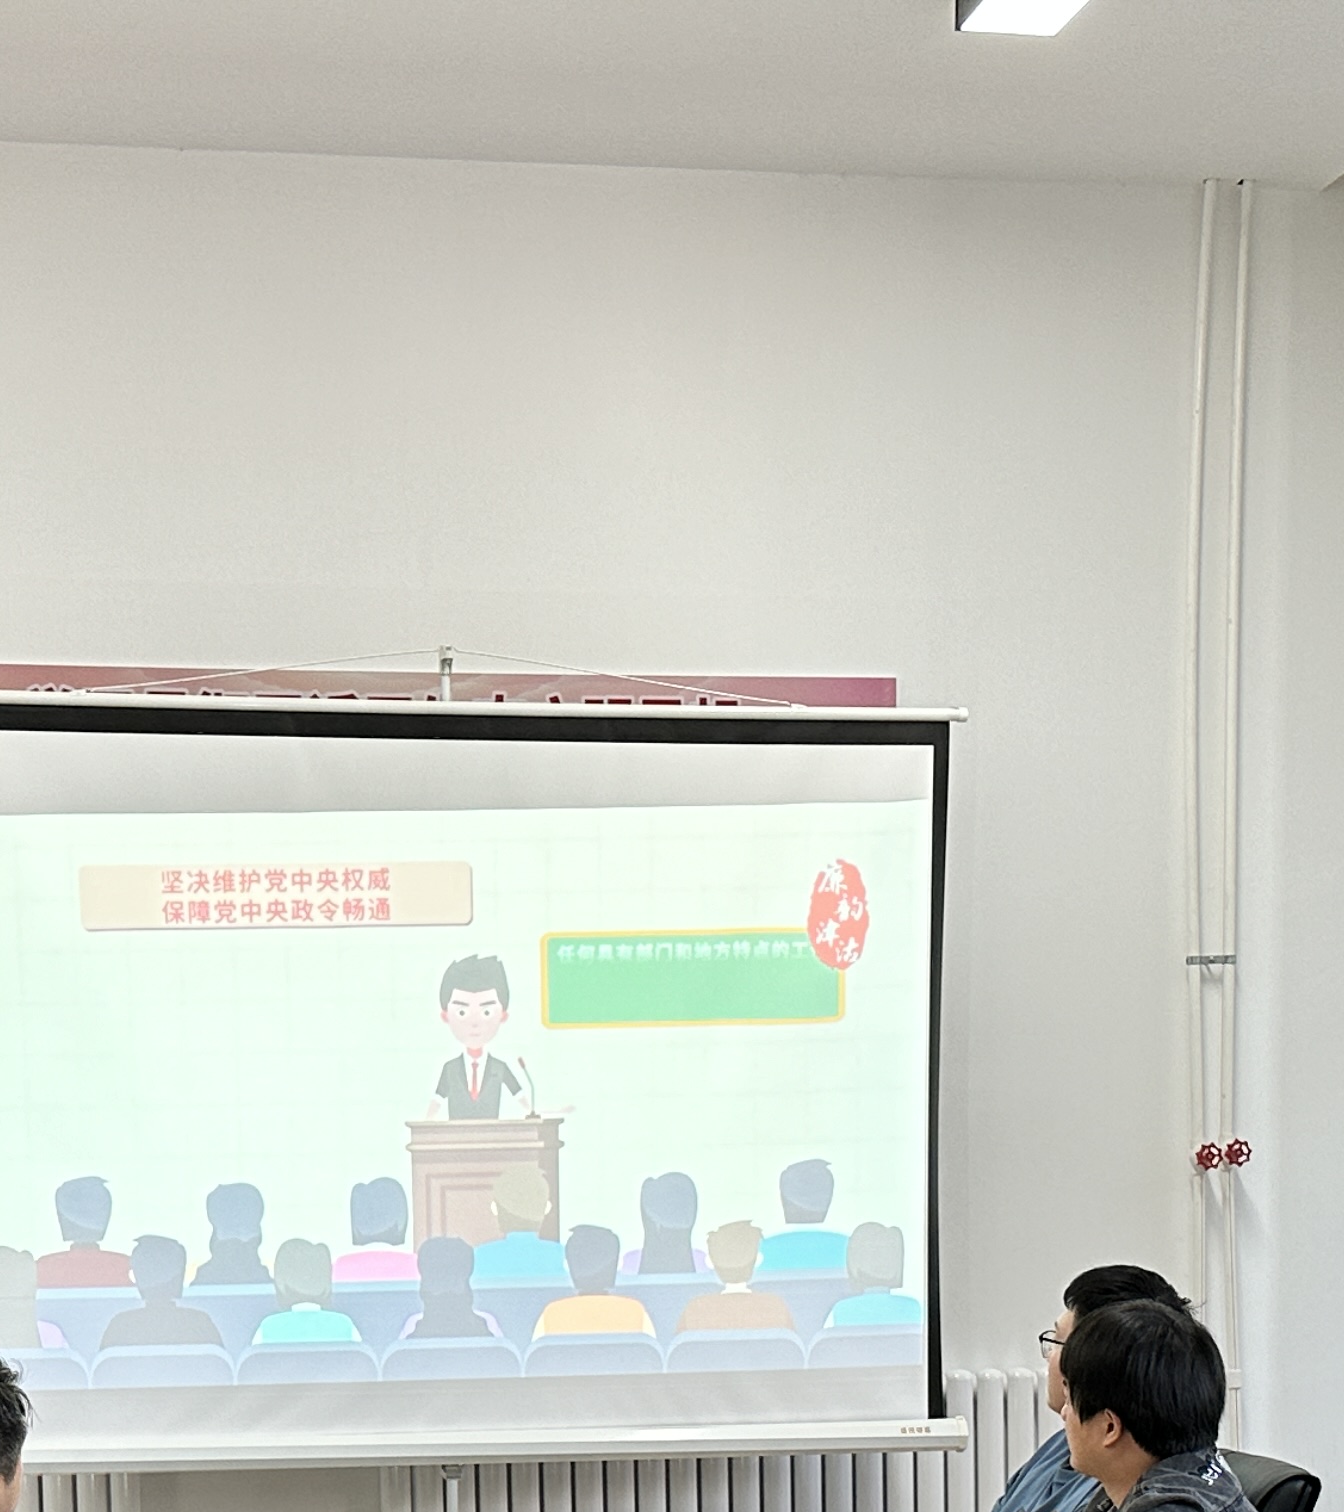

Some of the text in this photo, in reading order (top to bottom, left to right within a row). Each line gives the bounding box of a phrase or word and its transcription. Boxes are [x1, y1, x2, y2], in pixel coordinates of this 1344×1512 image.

[161, 867, 391, 894] 坚决维护党中央权威
[161, 897, 391, 924] 保障党中央政令畅通
